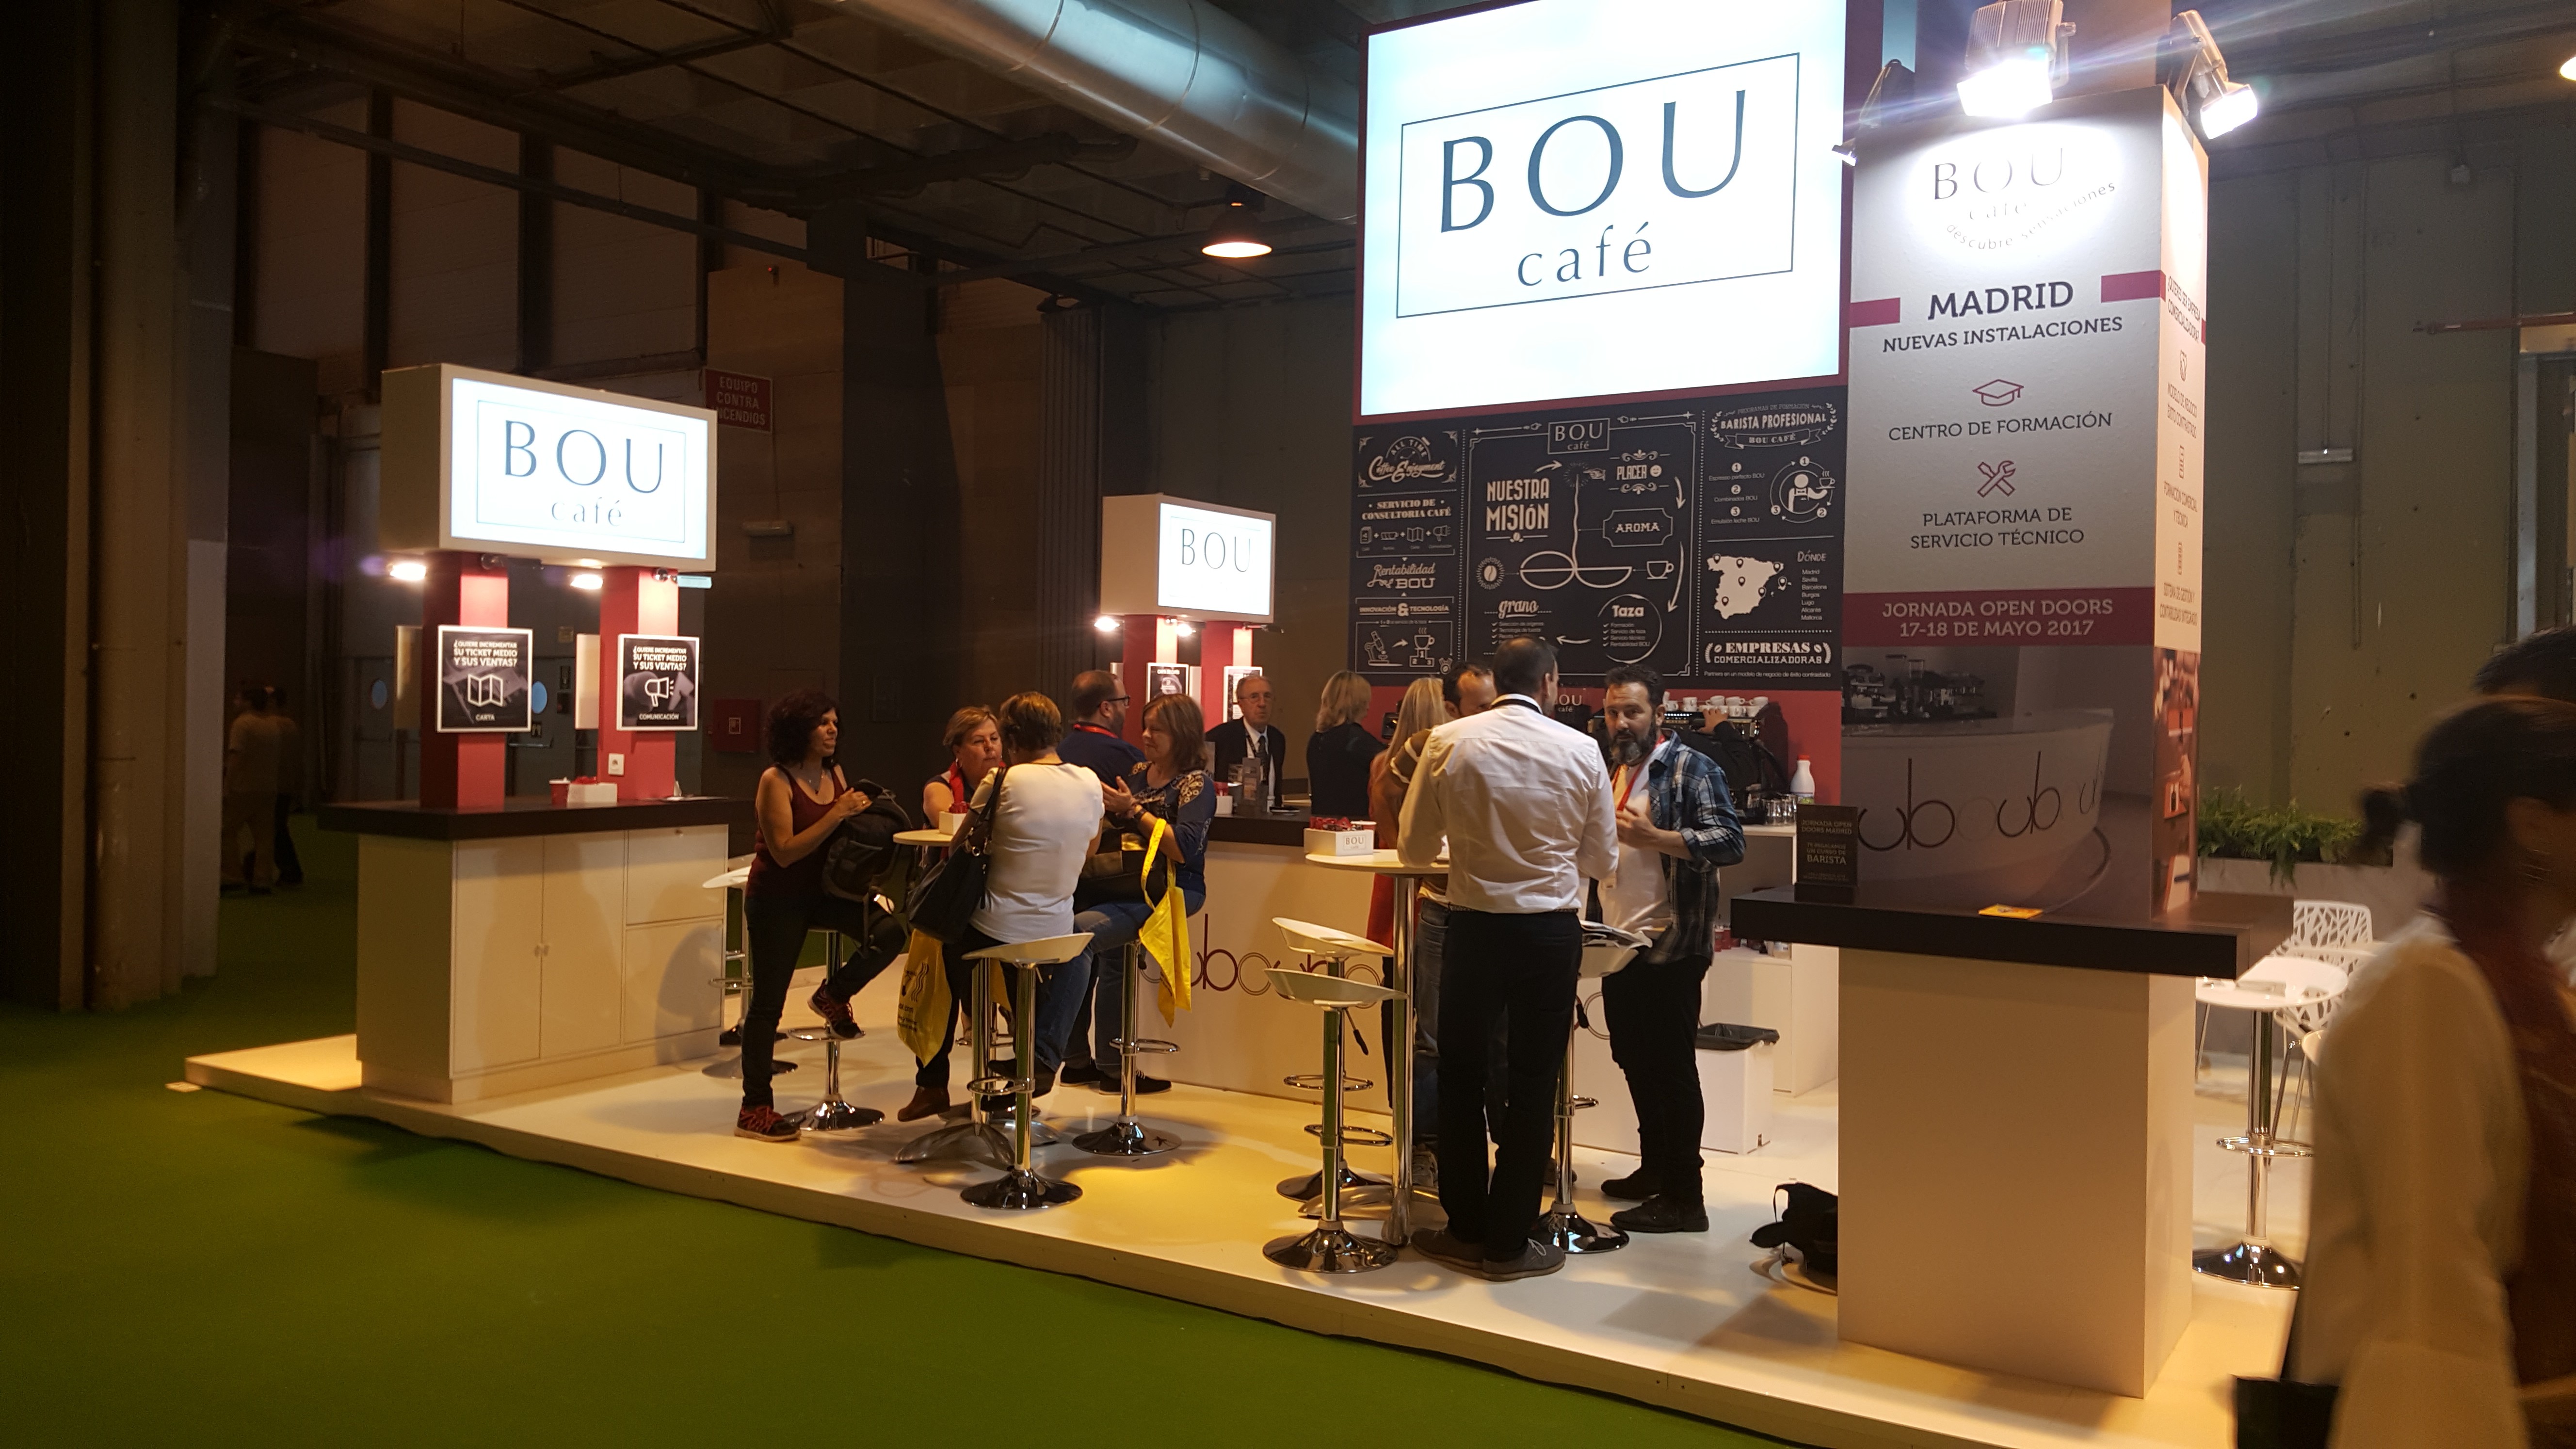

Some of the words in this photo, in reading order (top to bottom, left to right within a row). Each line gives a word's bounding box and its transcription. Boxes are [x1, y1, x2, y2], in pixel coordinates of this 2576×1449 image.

[1441, 90, 1745, 233] BOU
[1934, 147, 2062, 200] BOU
[1947, 224, 2012, 250] descubre
[1517, 221, 1651, 287] café
[1928, 281, 2074, 320] MADRID
[1883, 332, 1957, 353] NUEVAS
[1963, 317, 2123, 345] INSTALACIONES
[720, 376, 757, 394] EQUIPO
[717, 392, 759, 409] CONTRA
[717, 406, 765, 425] NCENDIOS
[1721, 416, 1759, 430] BARISTA
[1762, 413, 1826, 429] PROFESIONAL
[1555, 422, 1602, 441] BOU
[1889, 423, 1962, 441] CENTRO
[1968, 421, 1991, 435] DE
[1997, 411, 2112, 434] FORMACIÓN
[1567, 441, 1590, 451] café
[1771, 433, 1795, 443] CAFÉ
[505, 420, 662, 494] BOU
[1391, 441, 1405, 455] ALL
[1409, 439, 1428, 457] TIME
[1368, 455, 1396, 481] Coffee
[1616, 465, 1647, 480] PLACER
[1487, 478, 1550, 502] NUESTRA
[552, 497, 621, 526] café
[1362, 510, 1426, 520] CONSULTORIA
[1427, 506, 1451, 517] CAFÉ
[1377, 500, 1421, 509] SERVICIO
[1422, 499, 1436, 507] DE
[1486, 503, 1549, 531] MISIÓN
[1923, 509, 2042, 527] PLATAFORMA
[2047, 507, 2072, 522] DE
[1615, 522, 1660, 533] AROMA
[1911, 533, 1993, 549] SERVICIO
[1998, 529, 2084, 546] TÉCNICO
[1182, 528, 1251, 572] BOU
[1797, 549, 1827, 563] DÓNDE
[1374, 562, 1436, 578] Rentabilidad
[1395, 578, 1436, 589] BOU
[1397, 603, 1409, 616] &
[1498, 600, 1539, 619] grano
[1612, 605, 1644, 618] Taza
[1882, 601, 1975, 618] JORNADA
[1980, 600, 2035, 616] OPEN
[2041, 598, 2113, 615] DOORS
[1900, 622, 1948, 638] 17-18
[1953, 622, 1979, 637] DE
[1983, 620, 2042, 636] MAYO
[2047, 619, 2094, 636] 2017
[454, 640, 478, 648] ¿QUIERE
[1725, 642, 1810, 653] EMPRESAS
[454, 657, 460, 666] Y
[462, 658, 478, 666] SUS
[479, 658, 518, 667] VENTAS?
[655, 662, 687, 671] VENTAS?
[1714, 656, 1822, 664] COMERCIALIZADORAS
[1559, 694, 1582, 706] OU
[1346, 837, 1364, 845] BOU
[1807, 854, 1847, 865] BARISTA
